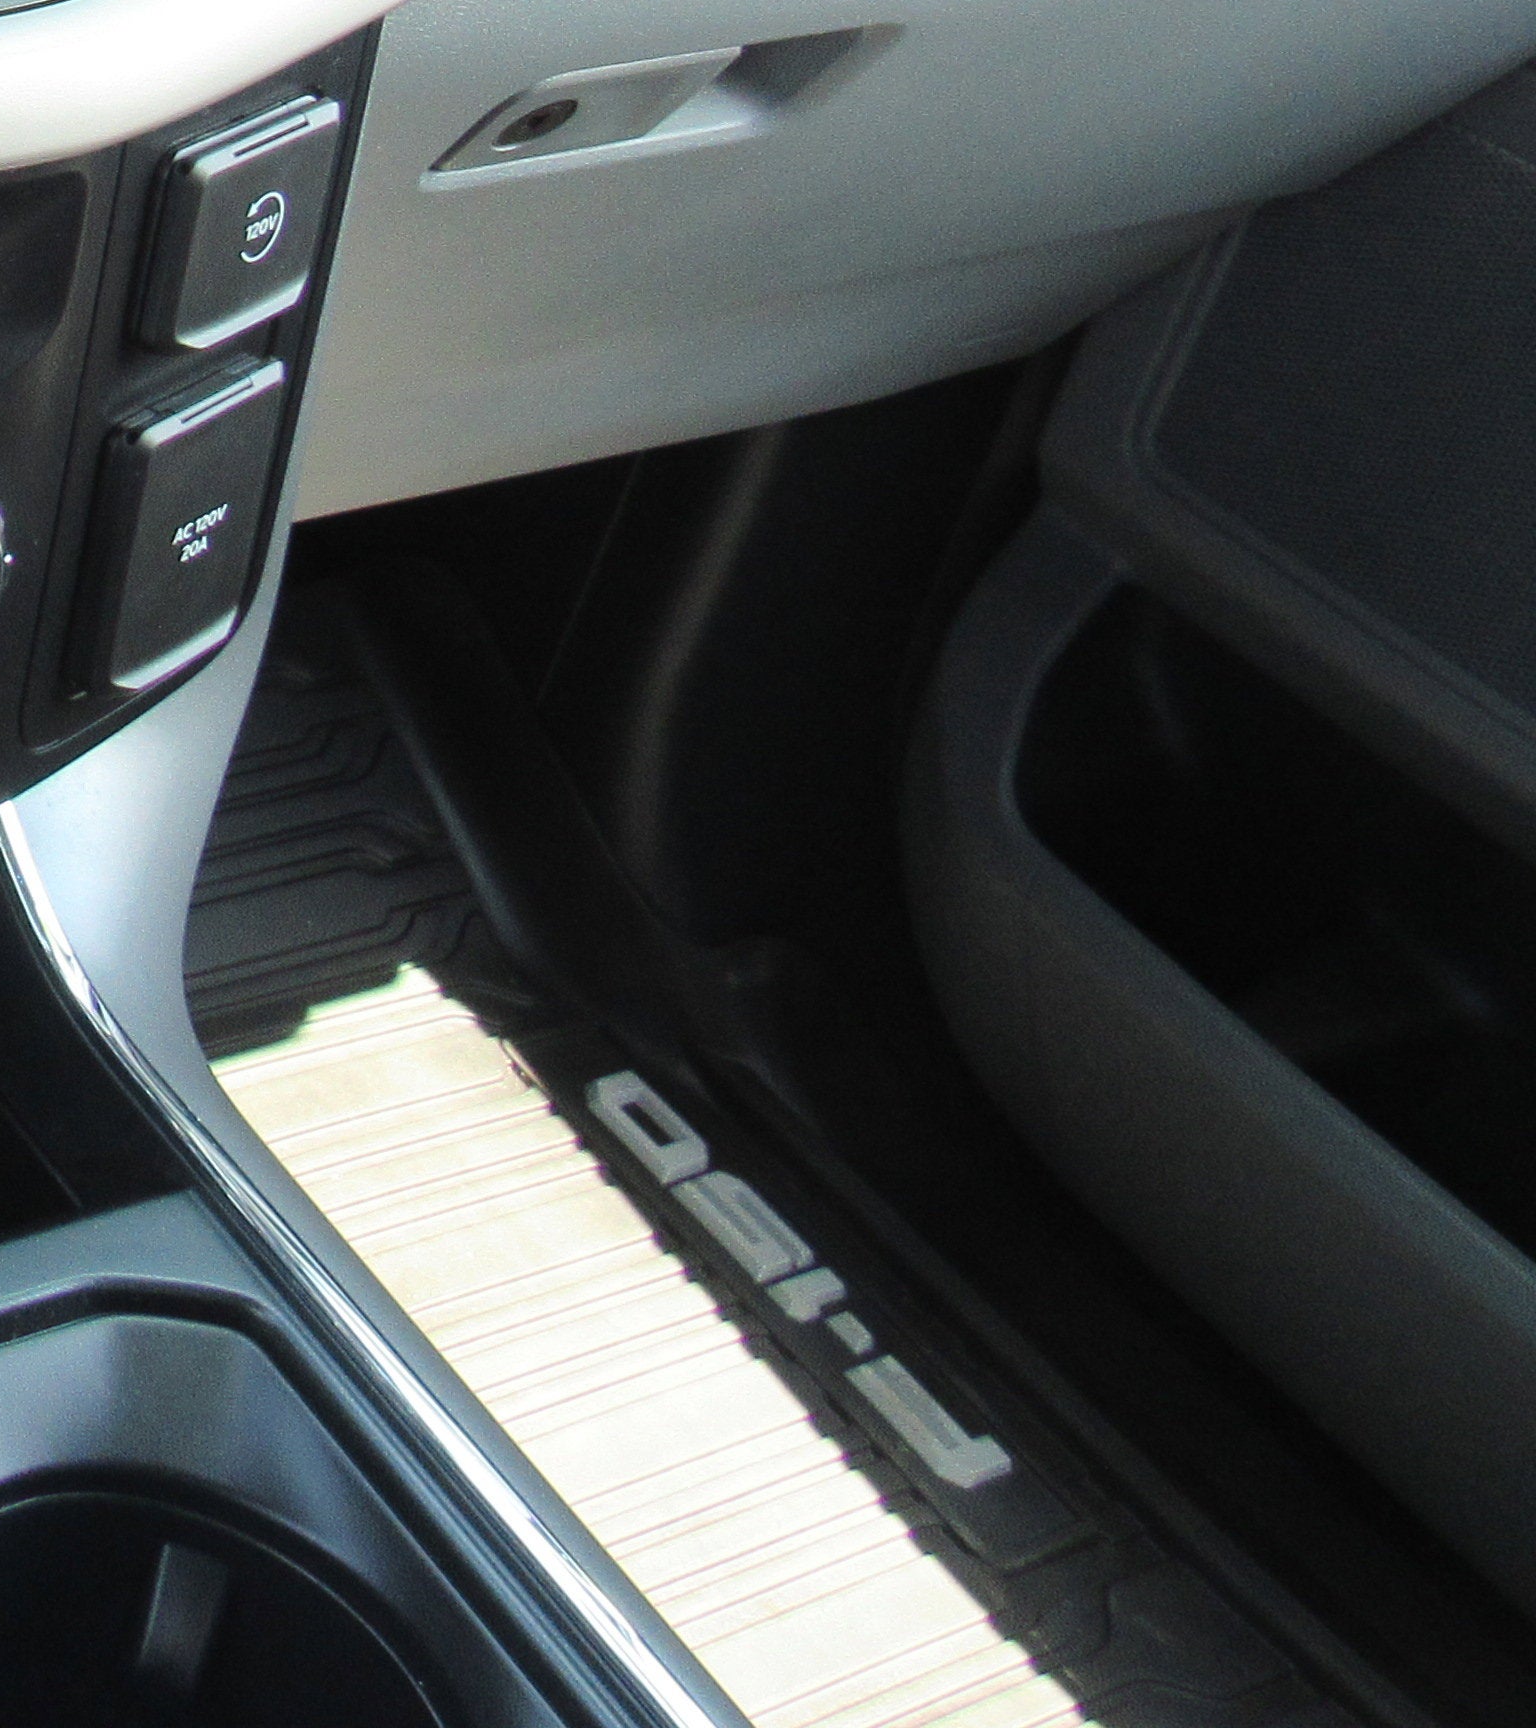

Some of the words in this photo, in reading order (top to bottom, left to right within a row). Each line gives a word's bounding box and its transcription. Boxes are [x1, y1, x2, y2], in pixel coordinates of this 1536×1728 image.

[246, 212, 279, 241] 120V
[171, 522, 194, 545] AC
[195, 503, 228, 534] 120V
[180, 535, 207, 562] 20A
[588, 1071, 1013, 1489] F-150
